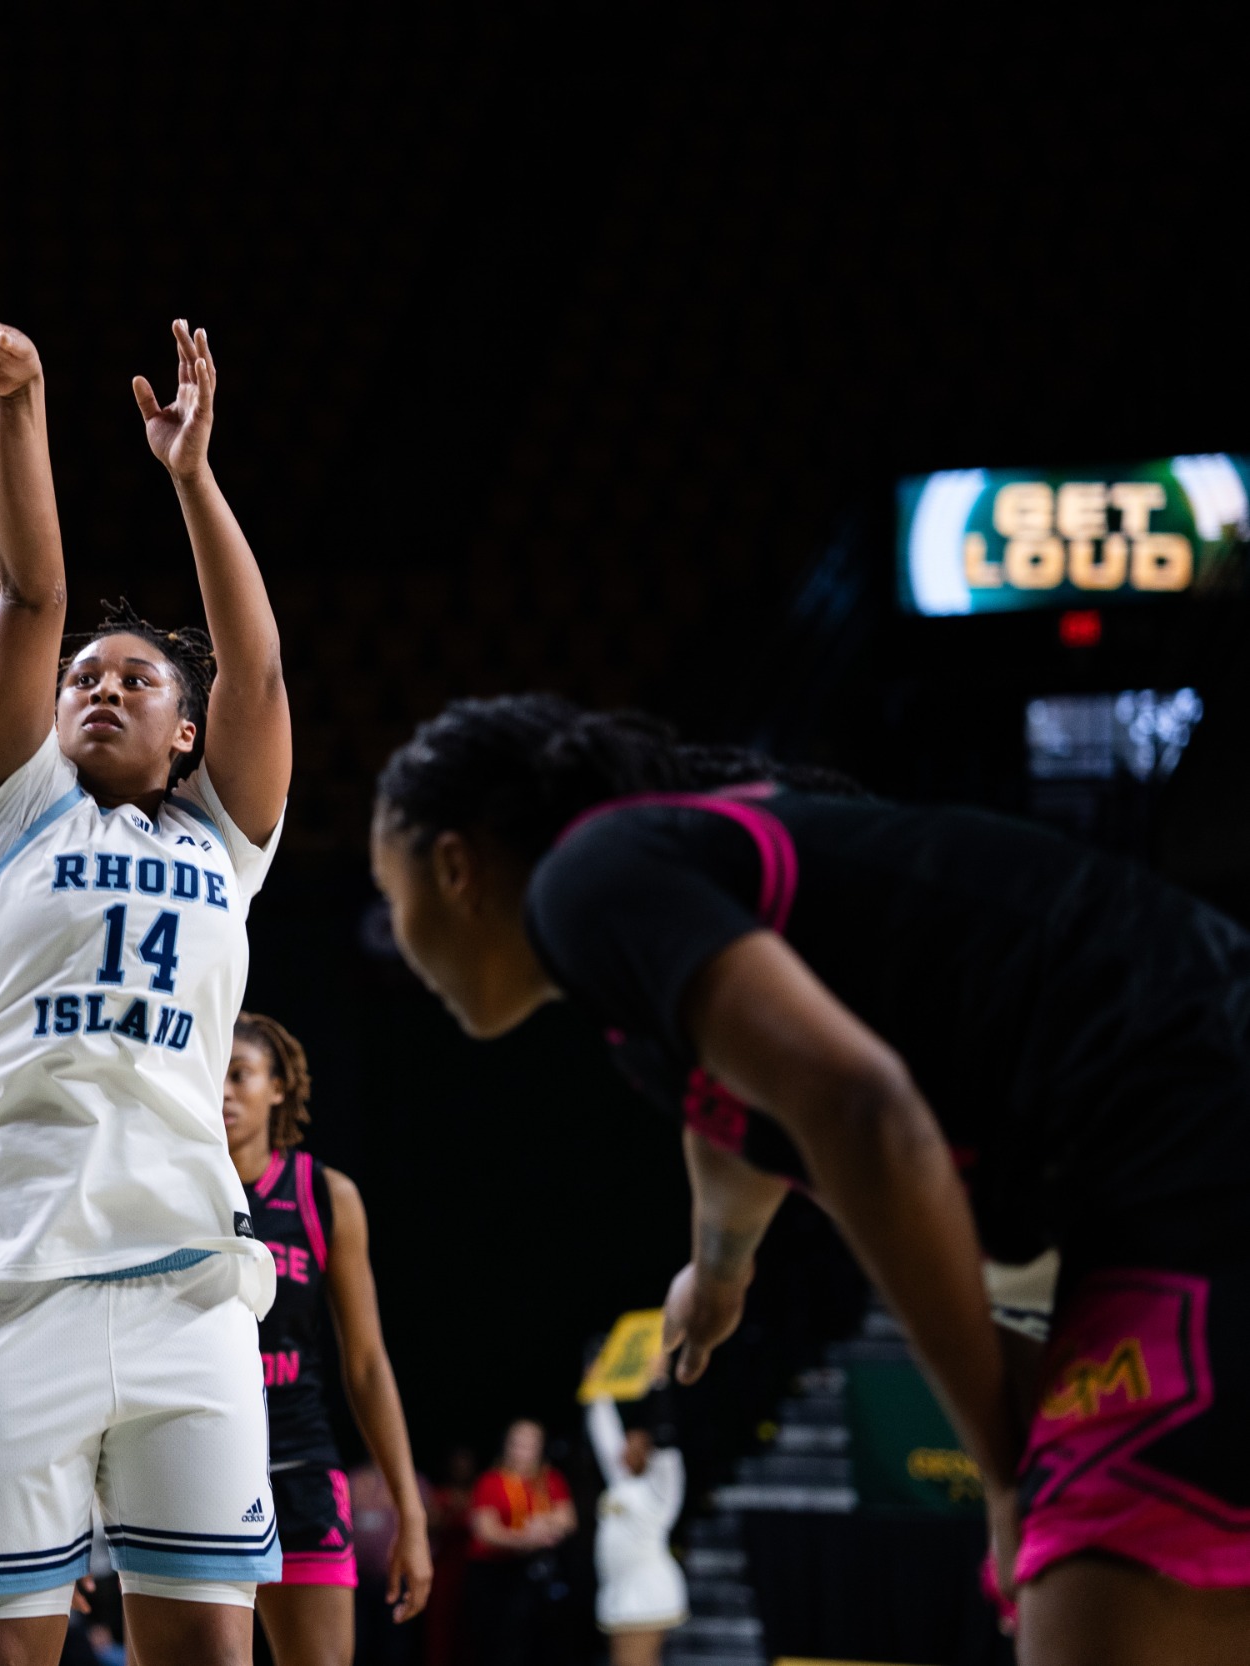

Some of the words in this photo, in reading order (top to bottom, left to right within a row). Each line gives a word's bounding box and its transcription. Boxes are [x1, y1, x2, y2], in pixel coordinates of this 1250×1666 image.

[994, 481, 1166, 538] GET
[965, 532, 1193, 592] LOUD
[52, 852, 230, 912] RHODE
[96, 902, 181, 994] 14
[32, 994, 194, 1052] ISLAND
